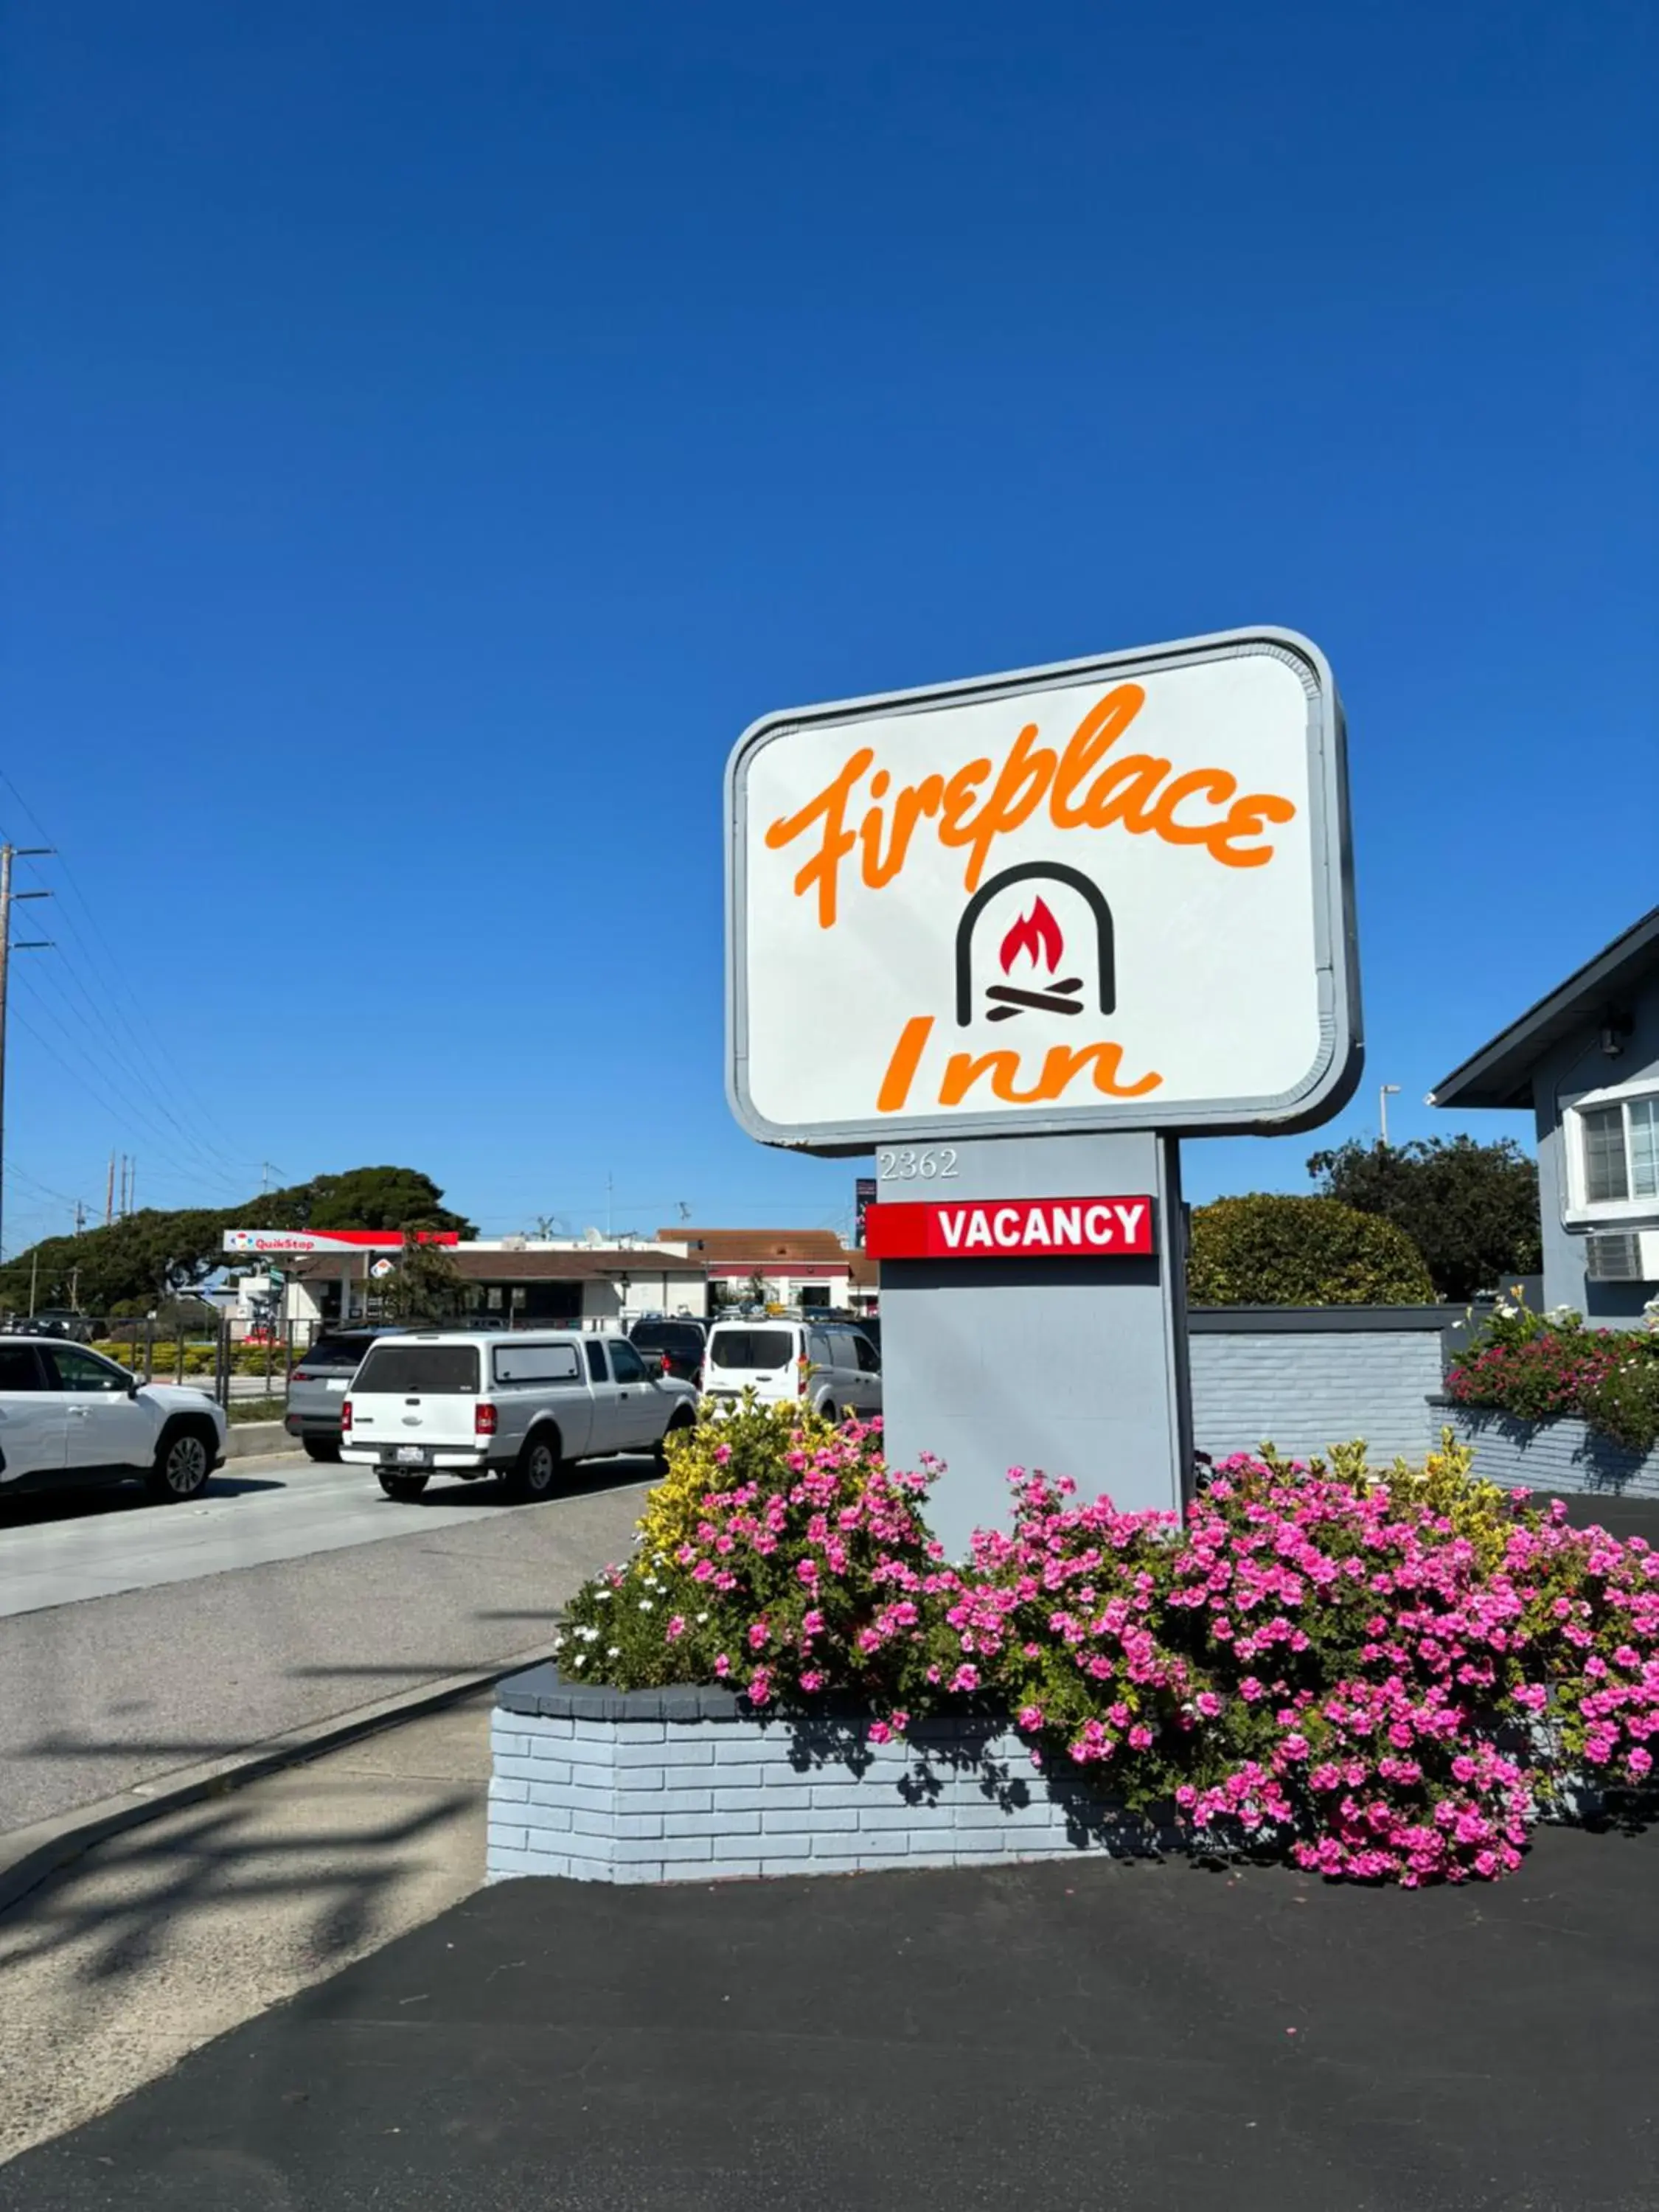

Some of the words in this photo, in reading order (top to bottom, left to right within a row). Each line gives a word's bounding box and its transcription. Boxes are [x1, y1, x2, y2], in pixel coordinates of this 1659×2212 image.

[765, 683, 1295, 929] Fireplace
[877, 1016, 1163, 1113] Inn
[880, 1148, 959, 1180] 2362
[938, 1204, 1145, 1248] VACANCY
